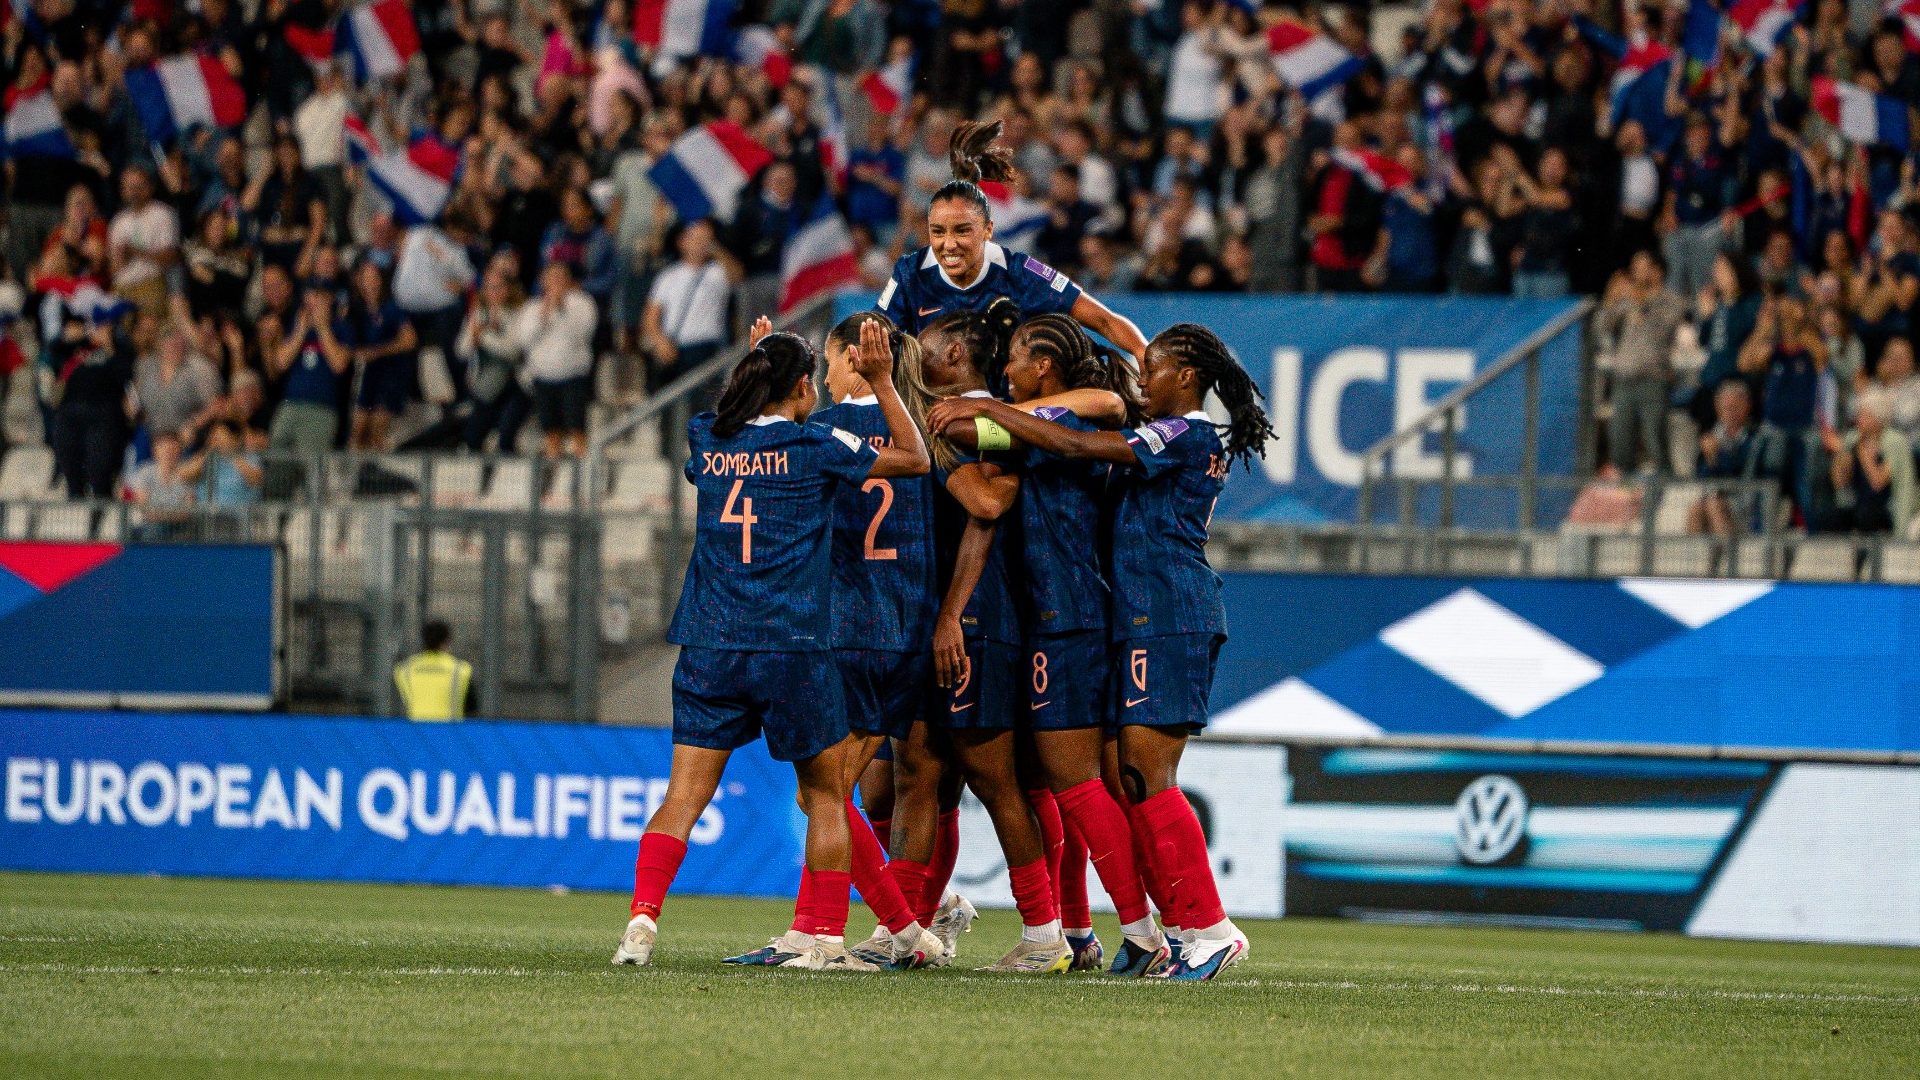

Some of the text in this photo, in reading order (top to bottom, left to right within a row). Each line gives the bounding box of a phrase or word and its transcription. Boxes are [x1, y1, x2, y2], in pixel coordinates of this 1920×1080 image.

[702, 451, 789, 476] SOMBATH
[719, 479, 758, 564] 4
[860, 478, 898, 561] 2
[1031, 651, 1048, 695] 8
[1130, 649, 1148, 692] 6
[6, 757, 343, 830] EUROPEAN
